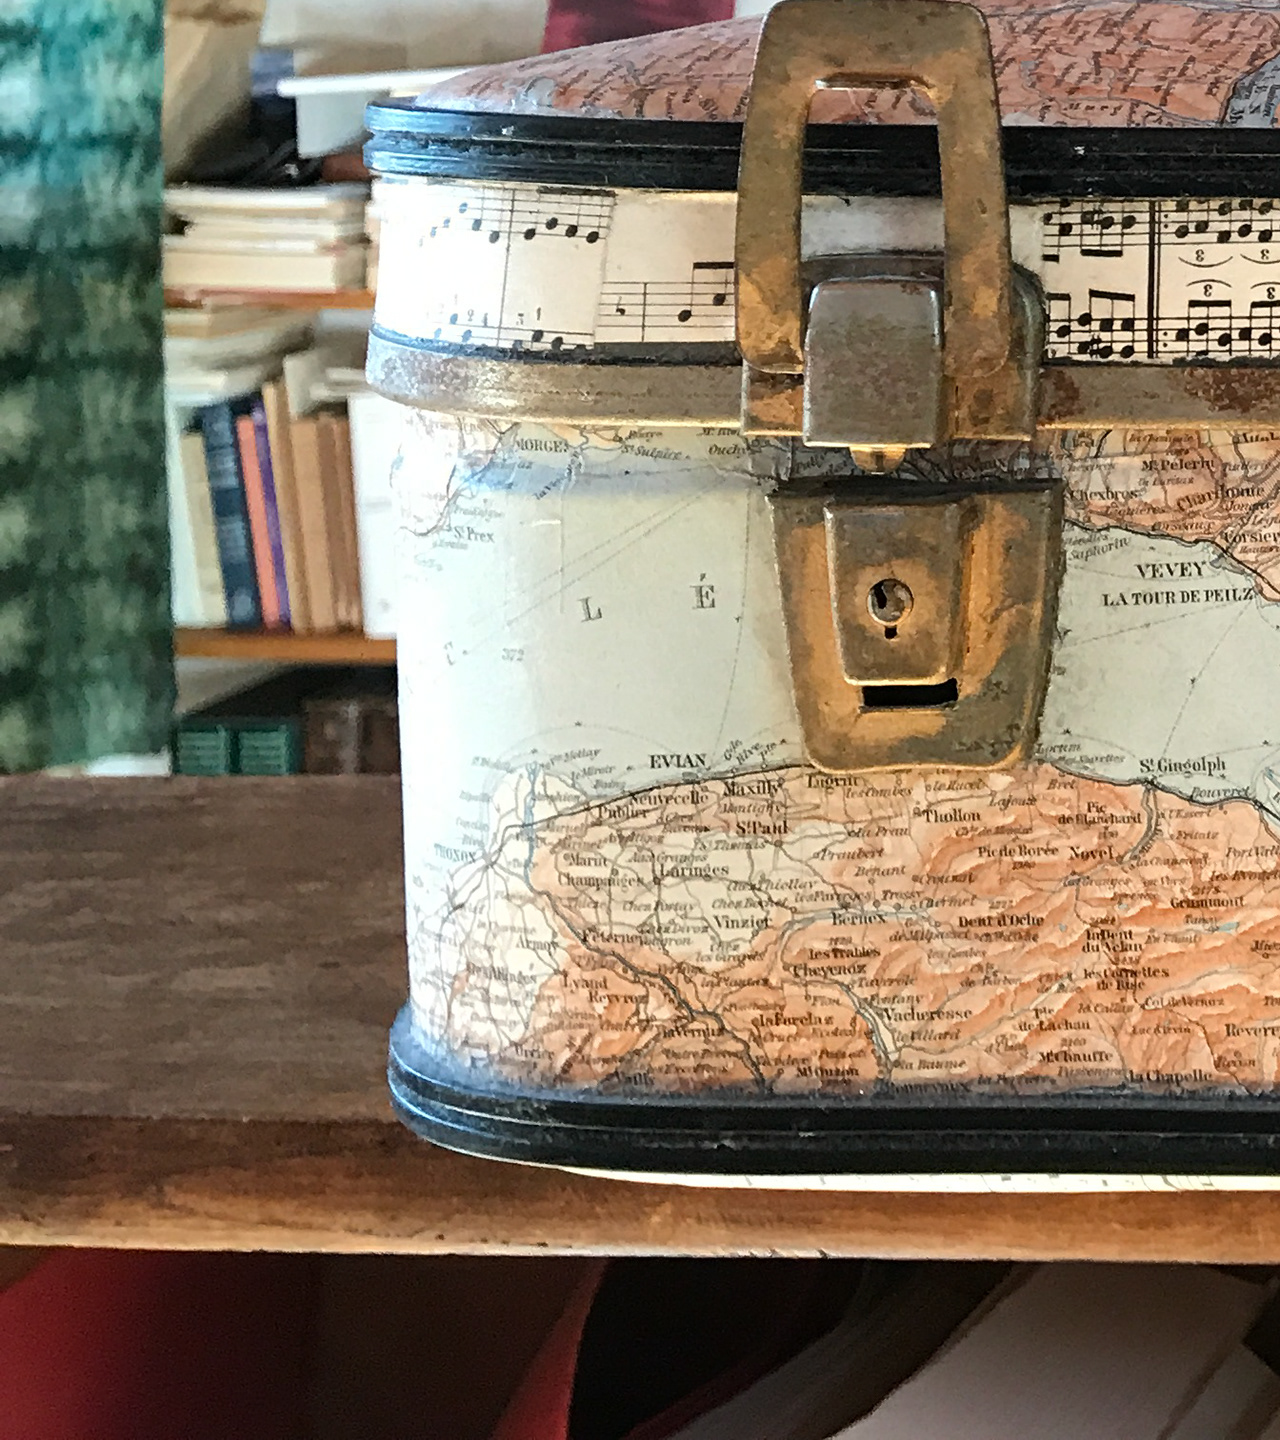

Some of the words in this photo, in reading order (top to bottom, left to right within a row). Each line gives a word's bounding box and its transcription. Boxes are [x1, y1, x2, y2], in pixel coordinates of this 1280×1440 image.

[467, 527, 494, 543] Prex
[1224, 531, 1280, 544] Corsier
[1137, 562, 1206, 578] VEVEY
[1103, 593, 1128, 607] LA
[1132, 591, 1175, 604] TOUR
[1180, 590, 1200, 603] DE
[1204, 587, 1253, 602] PEILZ
[650, 754, 706, 769] EVIAN
[1158, 759, 1226, 776] Gingolph
[724, 781, 779, 796] Maxilly
[630, 791, 708, 805] Neuvecelle
[599, 805, 646, 819] Publier
[924, 810, 980, 822] Thollon
[751, 821, 788, 834] Paul
[1071, 847, 1114, 860] Novel
[660, 863, 729, 876] Laringes
[558, 874, 642, 888] Champanges
[715, 915, 771, 929] Vinzier
[831, 913, 886, 926] Bernex
[959, 915, 996, 927] Dent
[884, 1008, 971, 1022] Vacheresse
[1141, 1069, 1212, 1083] Chapelle
